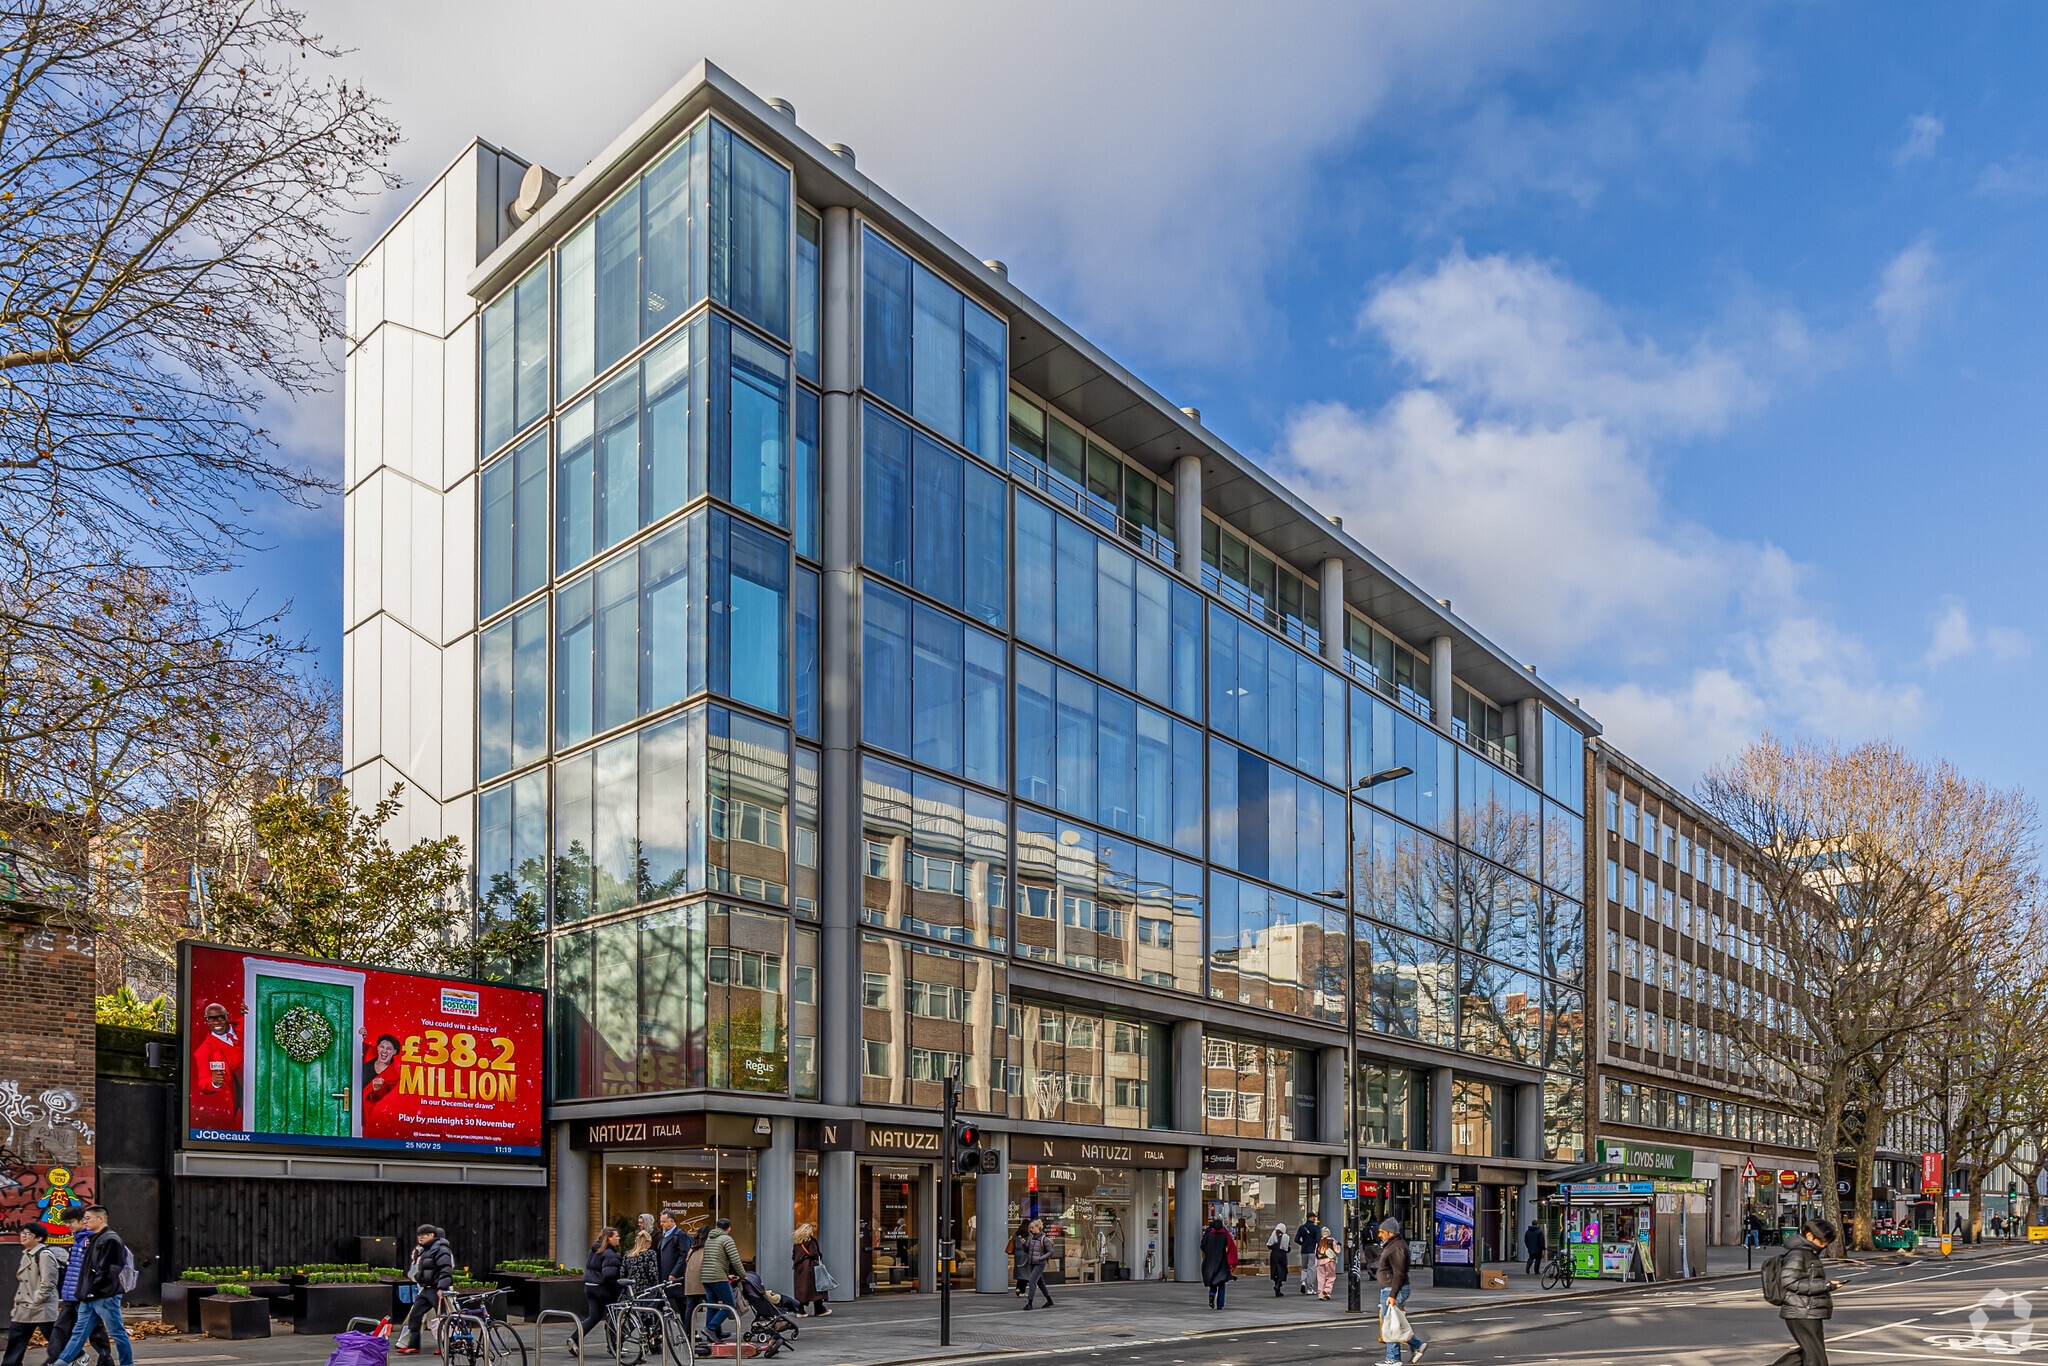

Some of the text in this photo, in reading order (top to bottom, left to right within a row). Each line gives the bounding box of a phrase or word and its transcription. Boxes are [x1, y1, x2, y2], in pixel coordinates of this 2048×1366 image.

[443, 1000, 477, 1011] POSTCODE
[421, 1018, 434, 1026] You
[435, 1020, 453, 1029] could
[454, 1022, 466, 1030] win
[472, 1024, 489, 1032] share
[401, 1030, 515, 1071] £38.2
[746, 1059, 774, 1075] Regus
[398, 1064, 517, 1103] MILLION
[441, 1100, 474, 1108] December
[398, 1113, 414, 1123] Play
[416, 1116, 426, 1124] by
[427, 1116, 464, 1126] midnight
[475, 1119, 515, 1128] November
[196, 1130, 251, 1141] JCDecaux
[589, 1123, 682, 1143] NATUZZI ITALIA
[824, 1126, 837, 1144] N
[870, 1130, 939, 1150] NATUZZI
[415, 1142, 432, 1150] NOV
[1043, 1142, 1054, 1157] N
[1081, 1144, 1164, 1161] NATUZZI ITALIA
[1210, 1154, 1235, 1163] Stressless
[1256, 1155, 1285, 1169] Stressless
[1626, 1150, 1675, 1169] LLOYDS BANK
[662, 1200, 704, 1209] The endless pursuit
